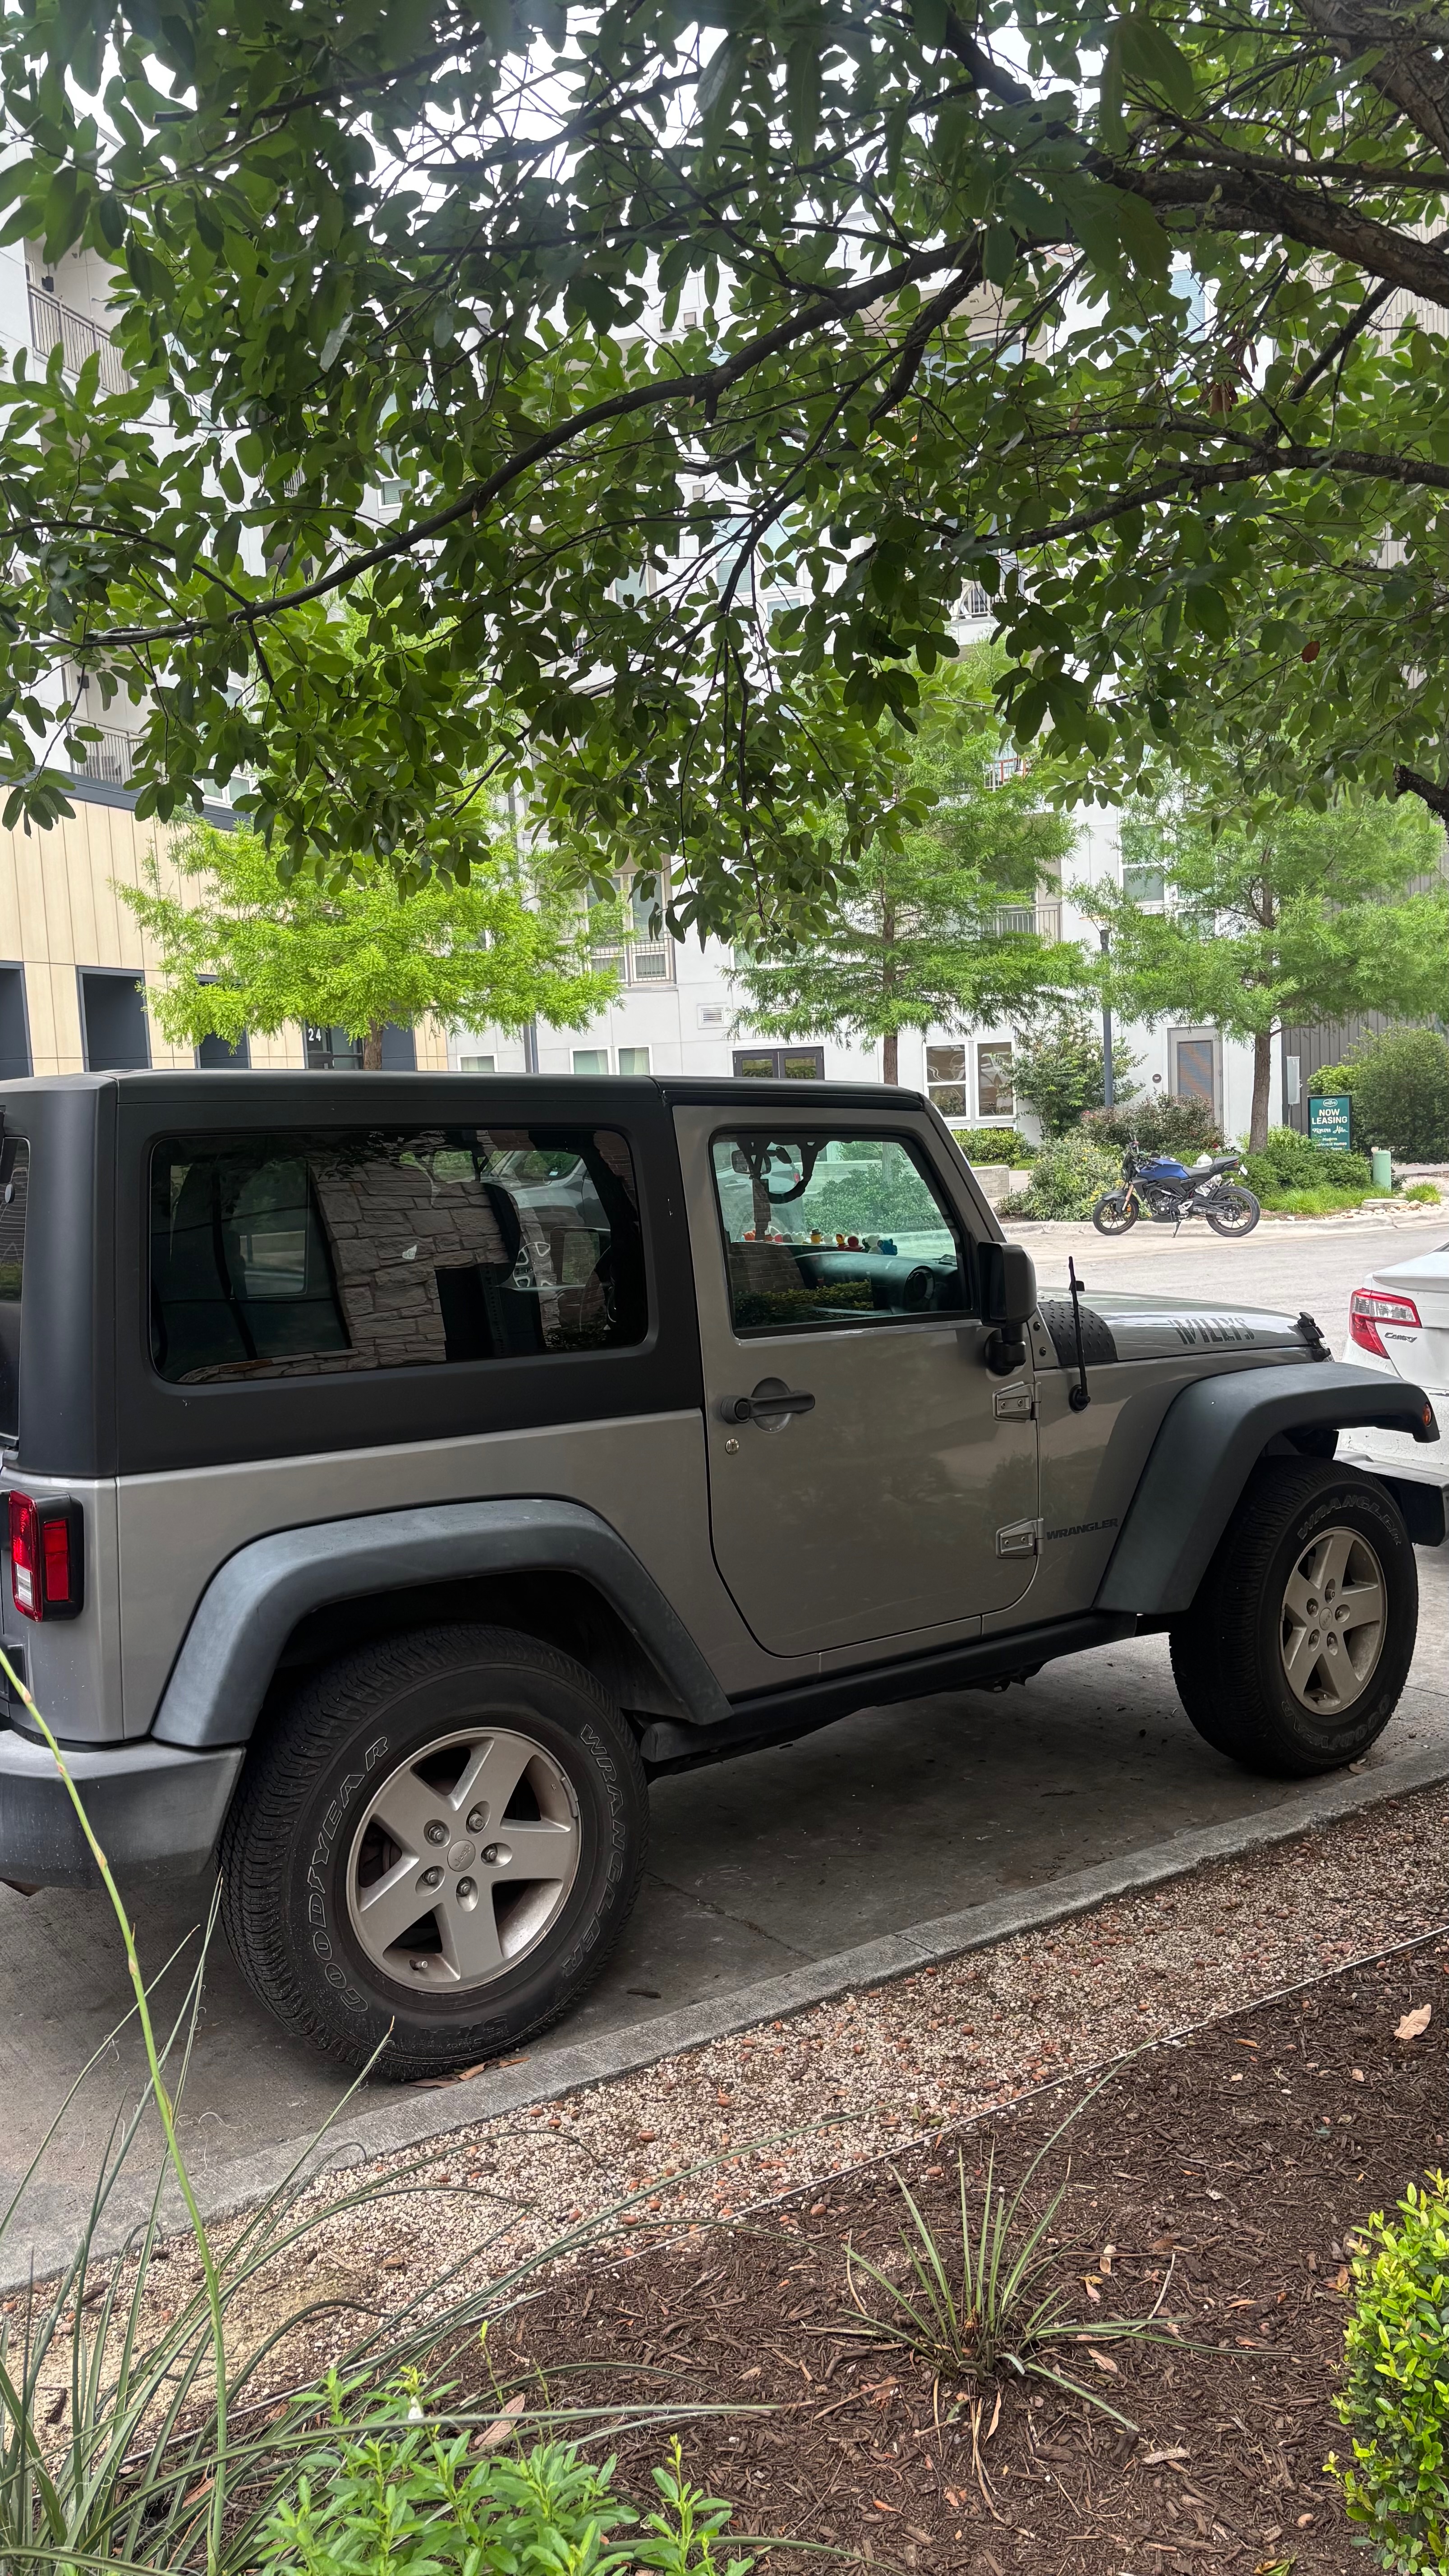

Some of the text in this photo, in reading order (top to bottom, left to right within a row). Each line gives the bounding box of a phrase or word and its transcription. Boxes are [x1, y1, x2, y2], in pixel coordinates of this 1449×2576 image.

[308, 1028, 322, 1041] 24
[1311, 1116, 1348, 1125] LEASING
[1167, 1317, 1255, 1345] WILLYS
[1384, 1332, 1417, 1343] Camry
[1046, 1518, 1119, 1541] WRANGLER
[1297, 1495, 1402, 1546] WRANGLER
[454, 1845, 471, 1868] Jeep
[560, 1724, 626, 1978] WRANGLER
[307, 1736, 388, 2012] GOODYEAR
